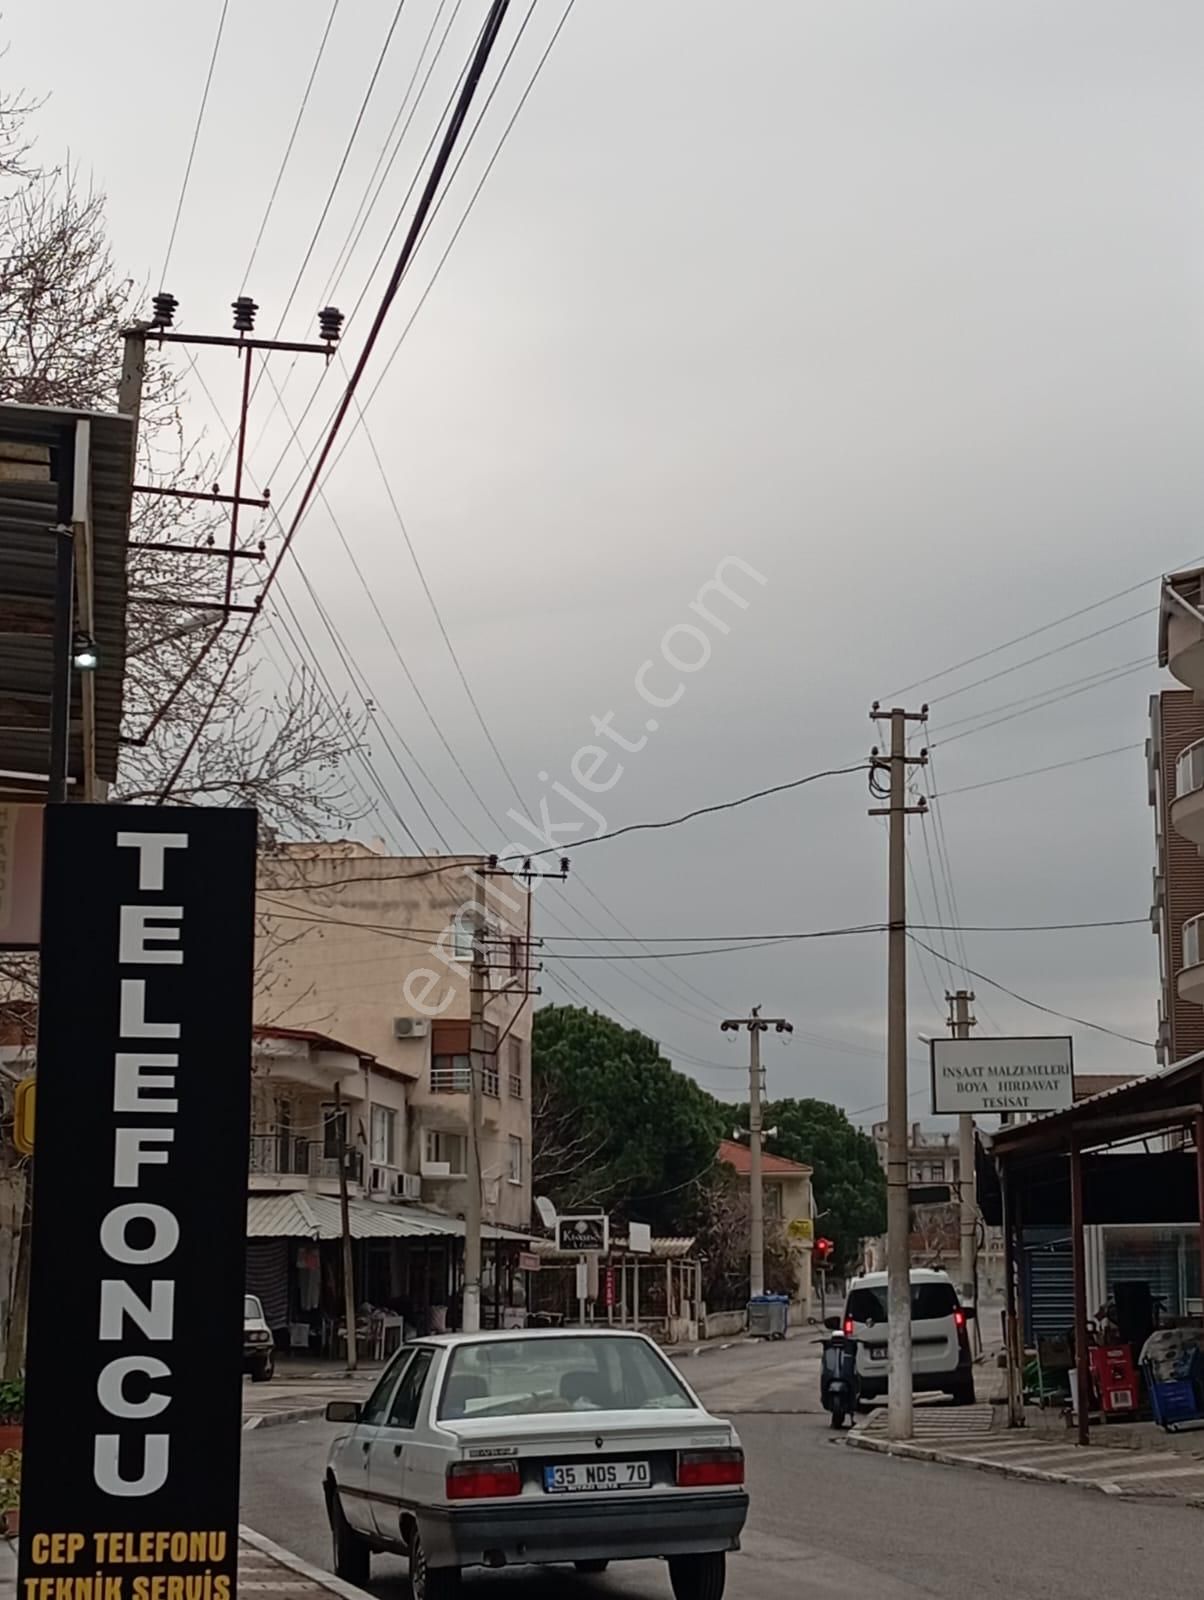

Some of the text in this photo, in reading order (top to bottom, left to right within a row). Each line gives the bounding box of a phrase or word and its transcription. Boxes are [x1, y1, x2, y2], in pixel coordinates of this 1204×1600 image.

[988, 1062, 1070, 1077] MALZEMELERİ
[957, 1080, 1060, 1093] BOYA HIRDAVAT
[982, 1096, 1030, 1108] TESİSAT
[93, 831, 189, 1497] TELEFONCU
[555, 1463, 647, 1485] 35 NDS 70
[32, 1531, 227, 1565] CEP TELEFONU
[24, 1569, 231, 1600] TEKNİK SERVİS
